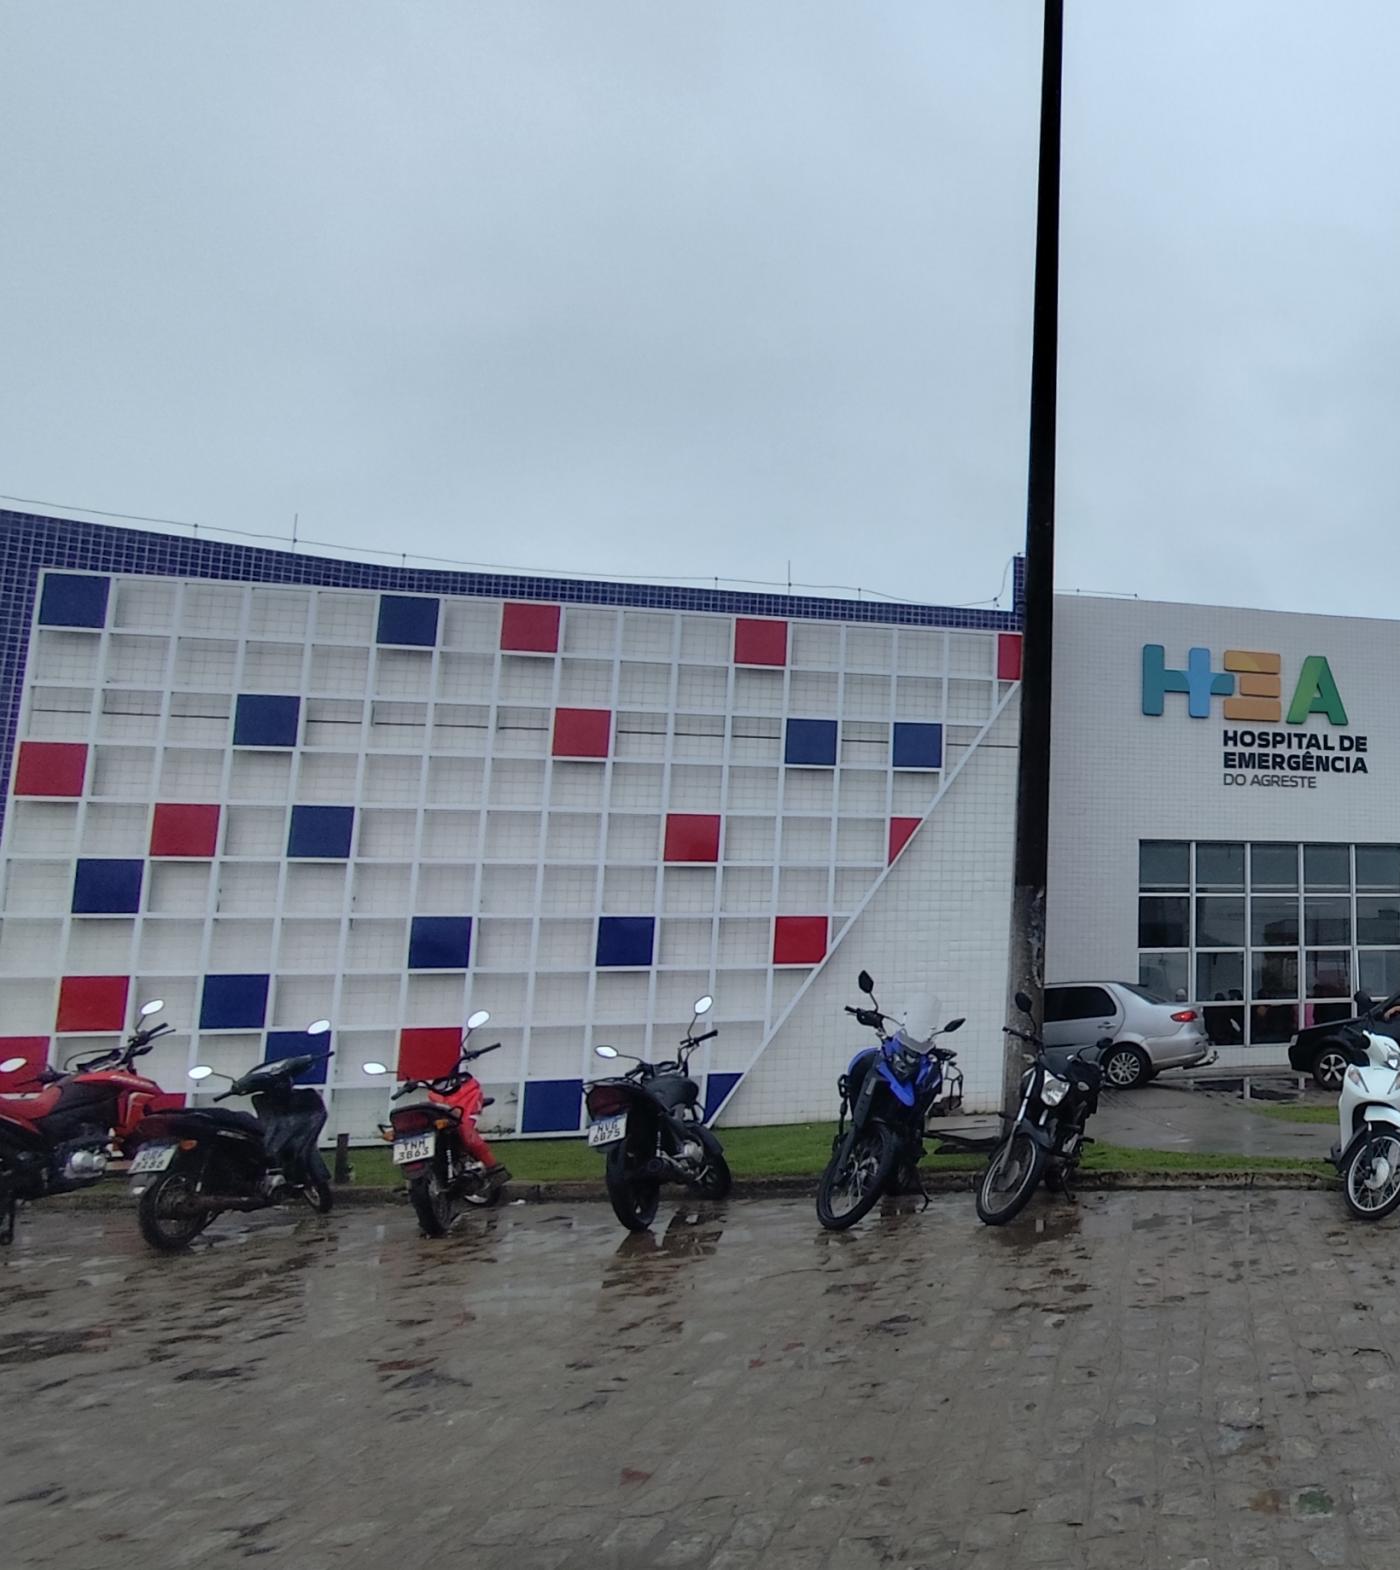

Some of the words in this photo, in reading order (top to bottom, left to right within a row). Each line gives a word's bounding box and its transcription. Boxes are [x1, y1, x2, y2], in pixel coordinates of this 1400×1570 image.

[1223, 729, 1335, 751] HOSPITAL
[1339, 735, 1368, 753] DE
[1223, 751, 1369, 774] EMERGÊNCIA
[1223, 773, 1246, 786] DO
[1250, 774, 1317, 789] AGRESTE
